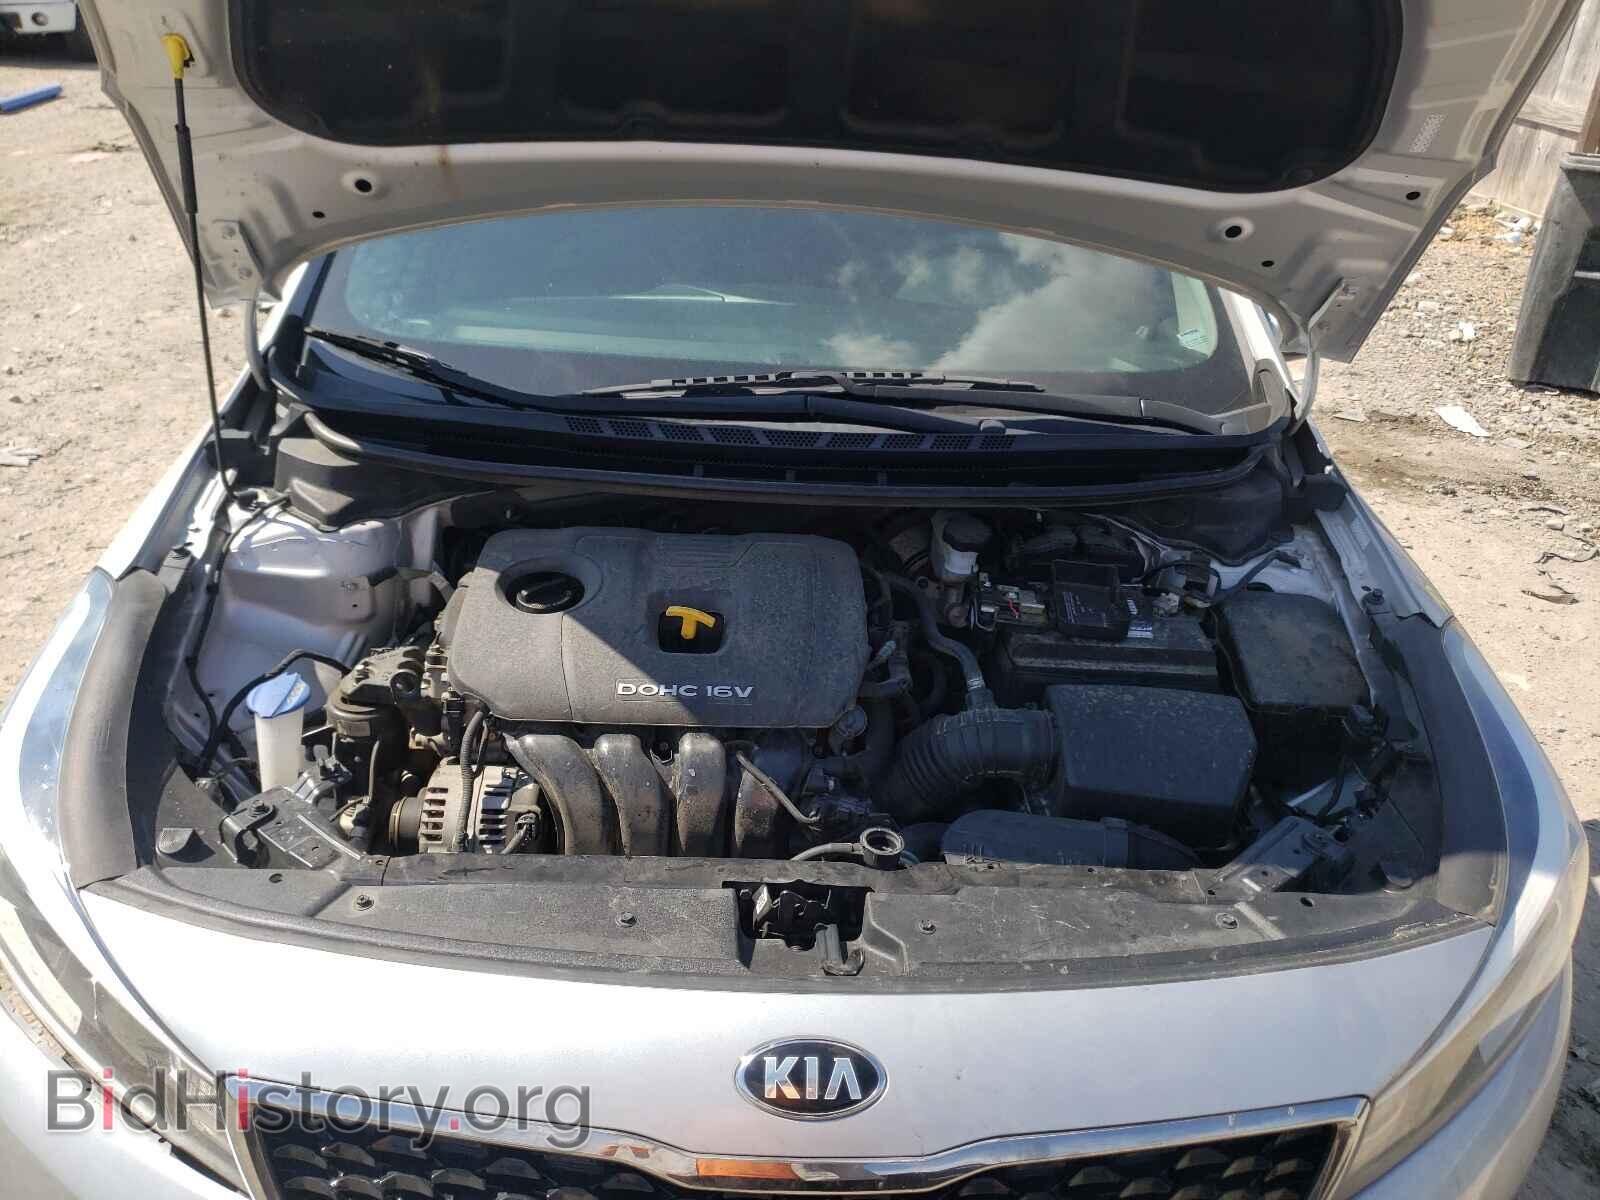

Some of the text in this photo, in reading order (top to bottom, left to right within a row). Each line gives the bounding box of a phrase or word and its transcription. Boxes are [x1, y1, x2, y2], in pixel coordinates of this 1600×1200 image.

[617, 683, 753, 698] DOHC 16V
[763, 1056, 862, 1100] KIA
